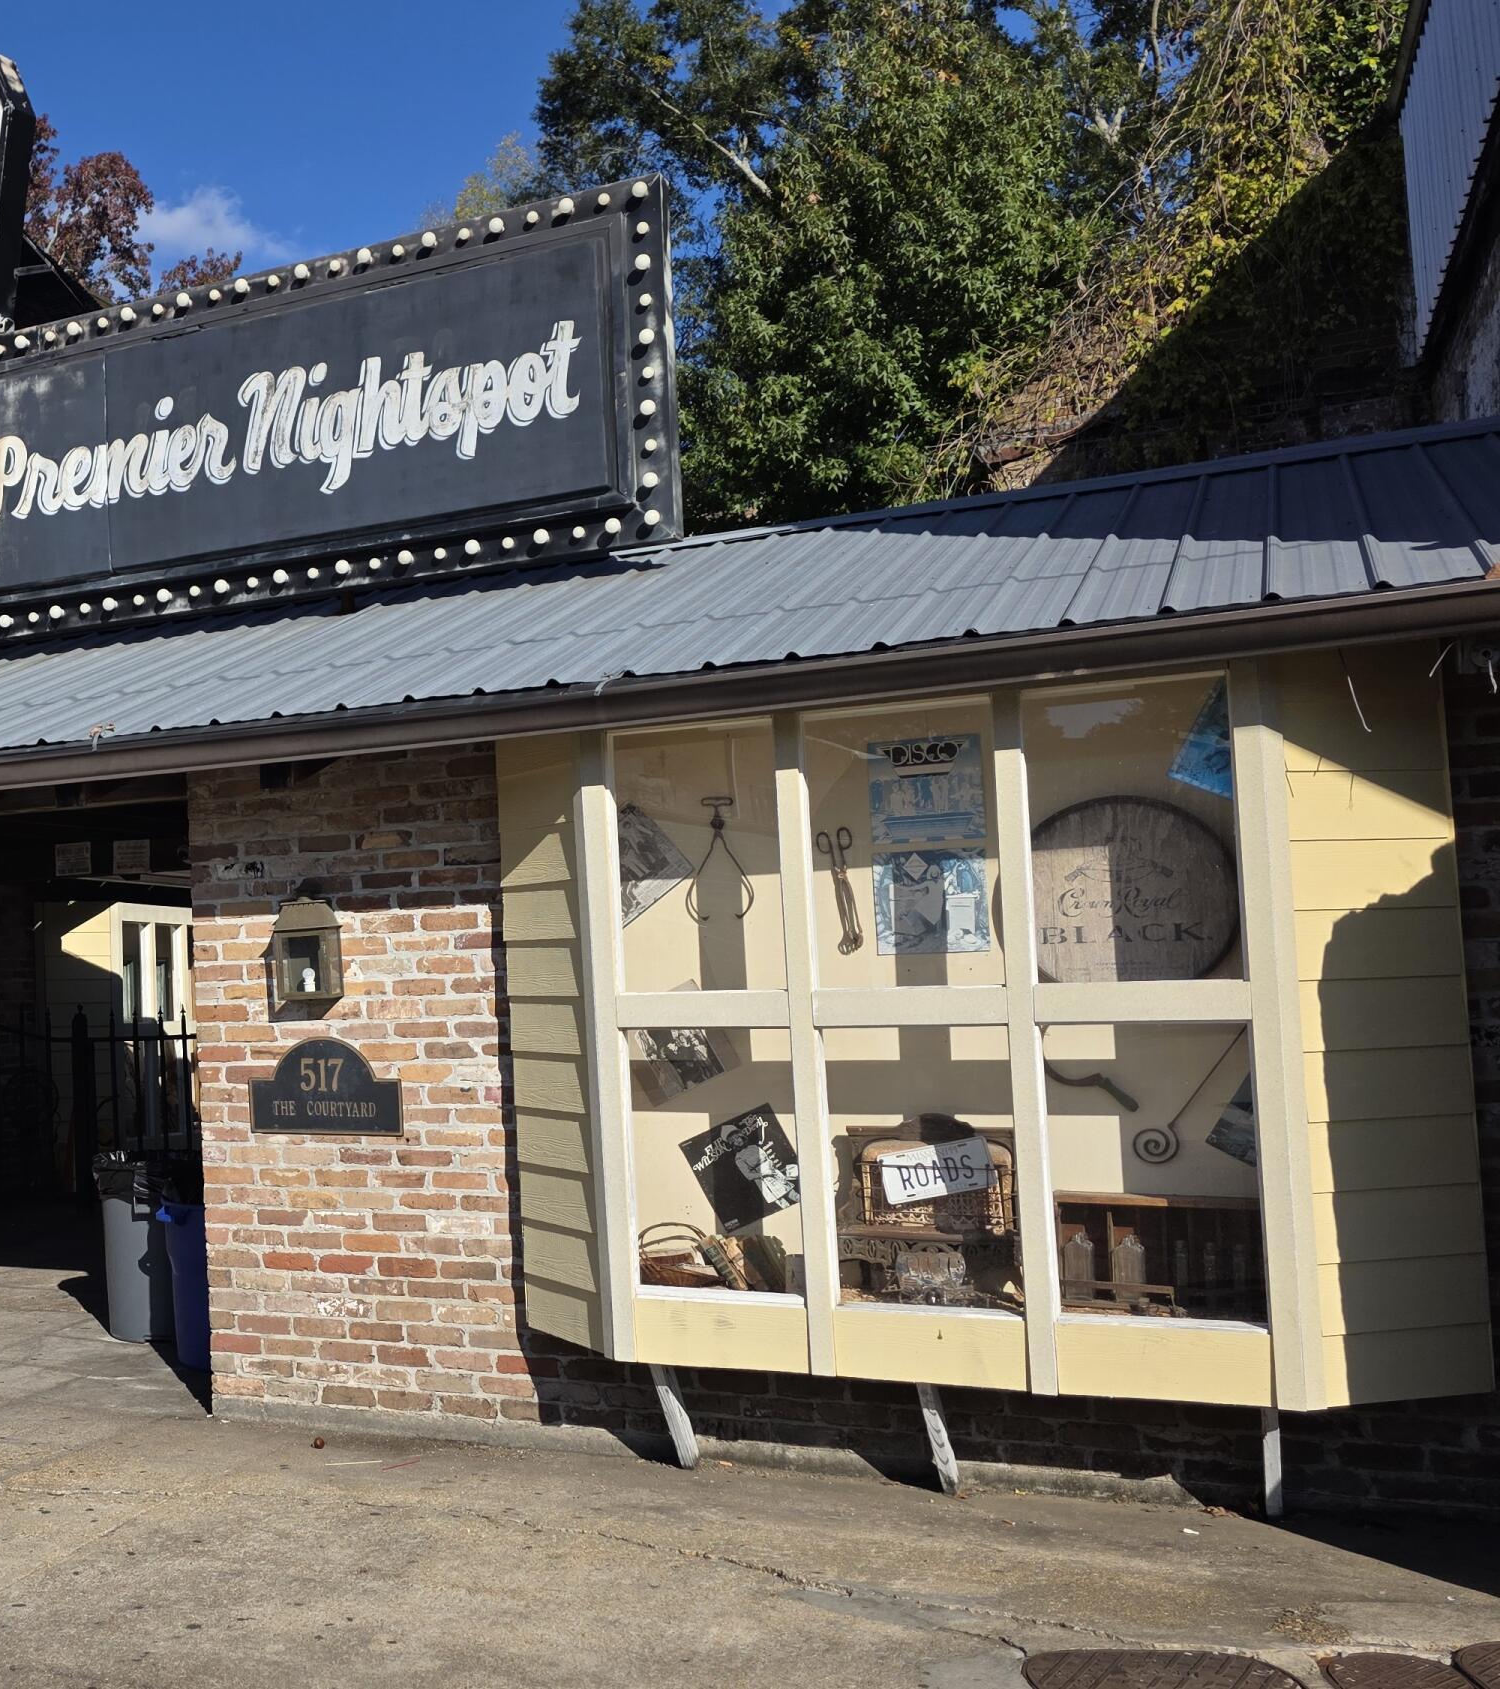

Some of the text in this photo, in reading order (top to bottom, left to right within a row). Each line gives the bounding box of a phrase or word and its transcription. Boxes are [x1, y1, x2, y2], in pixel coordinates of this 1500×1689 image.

[238, 320, 583, 494] Nightspot
[890, 741, 960, 766] DISCO
[1058, 887, 1182, 918] Crown Royal
[300, 1058, 344, 1092] 517
[273, 1100, 376, 1118] THE COURTYARD
[693, 1141, 732, 1171] WILSON
[705, 1137, 723, 1156] FLIP
[897, 1155, 974, 1190] ROADS
